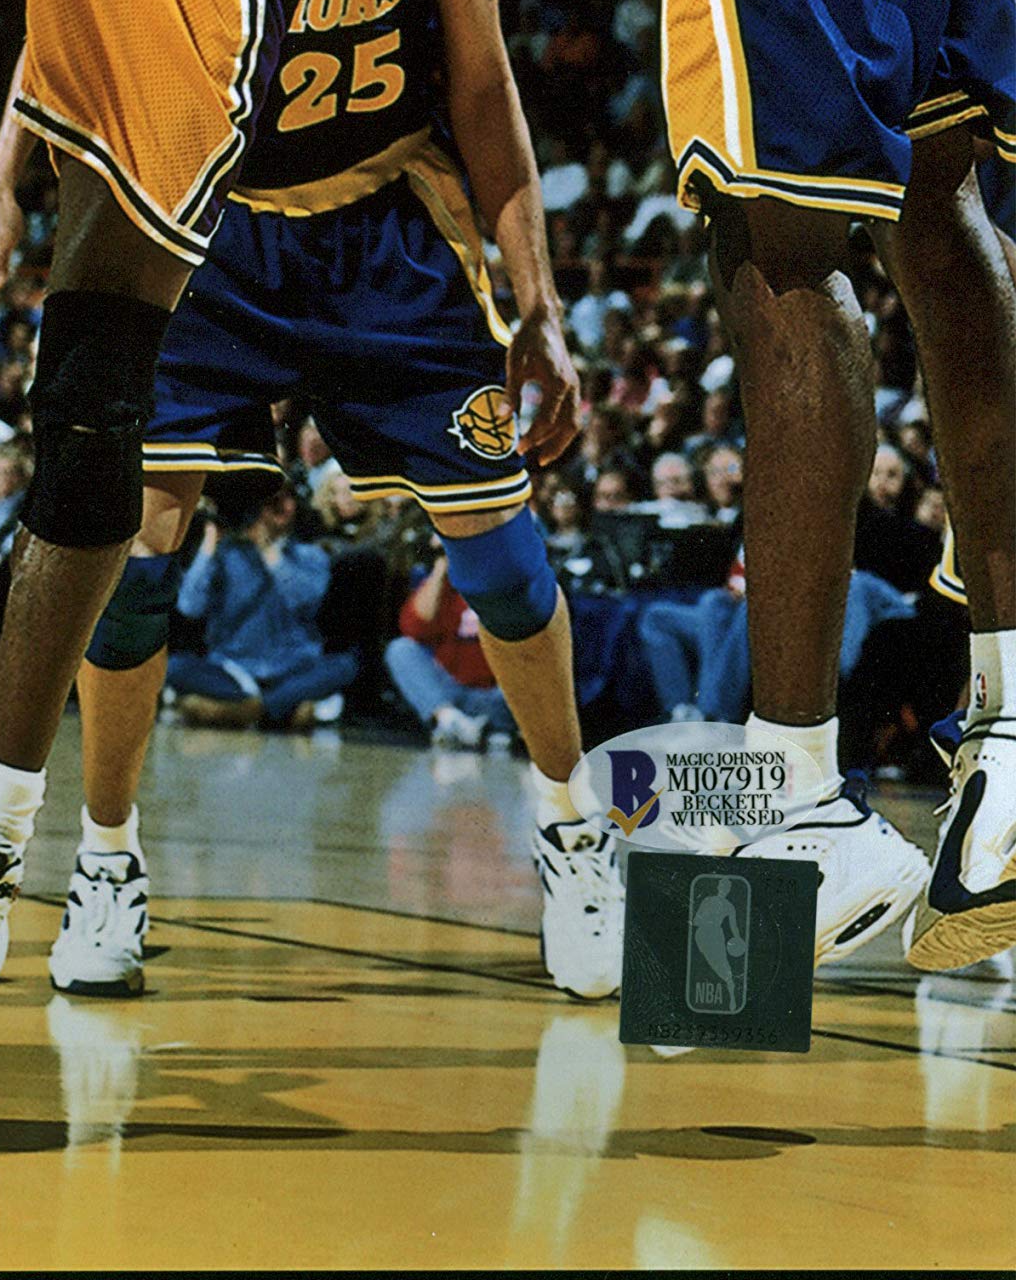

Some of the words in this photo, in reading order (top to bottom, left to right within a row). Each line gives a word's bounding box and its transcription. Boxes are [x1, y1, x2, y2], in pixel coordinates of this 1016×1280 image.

[277, 28, 405, 132] 25
[666, 753, 714, 767] MAGIC
[715, 751, 786, 767] JOHNSON
[667, 766, 786, 794] MJ07919
[682, 794, 772, 810] BECKETT
[670, 809, 785, 826] WITNESSED
[695, 982, 723, 1005] NBA
